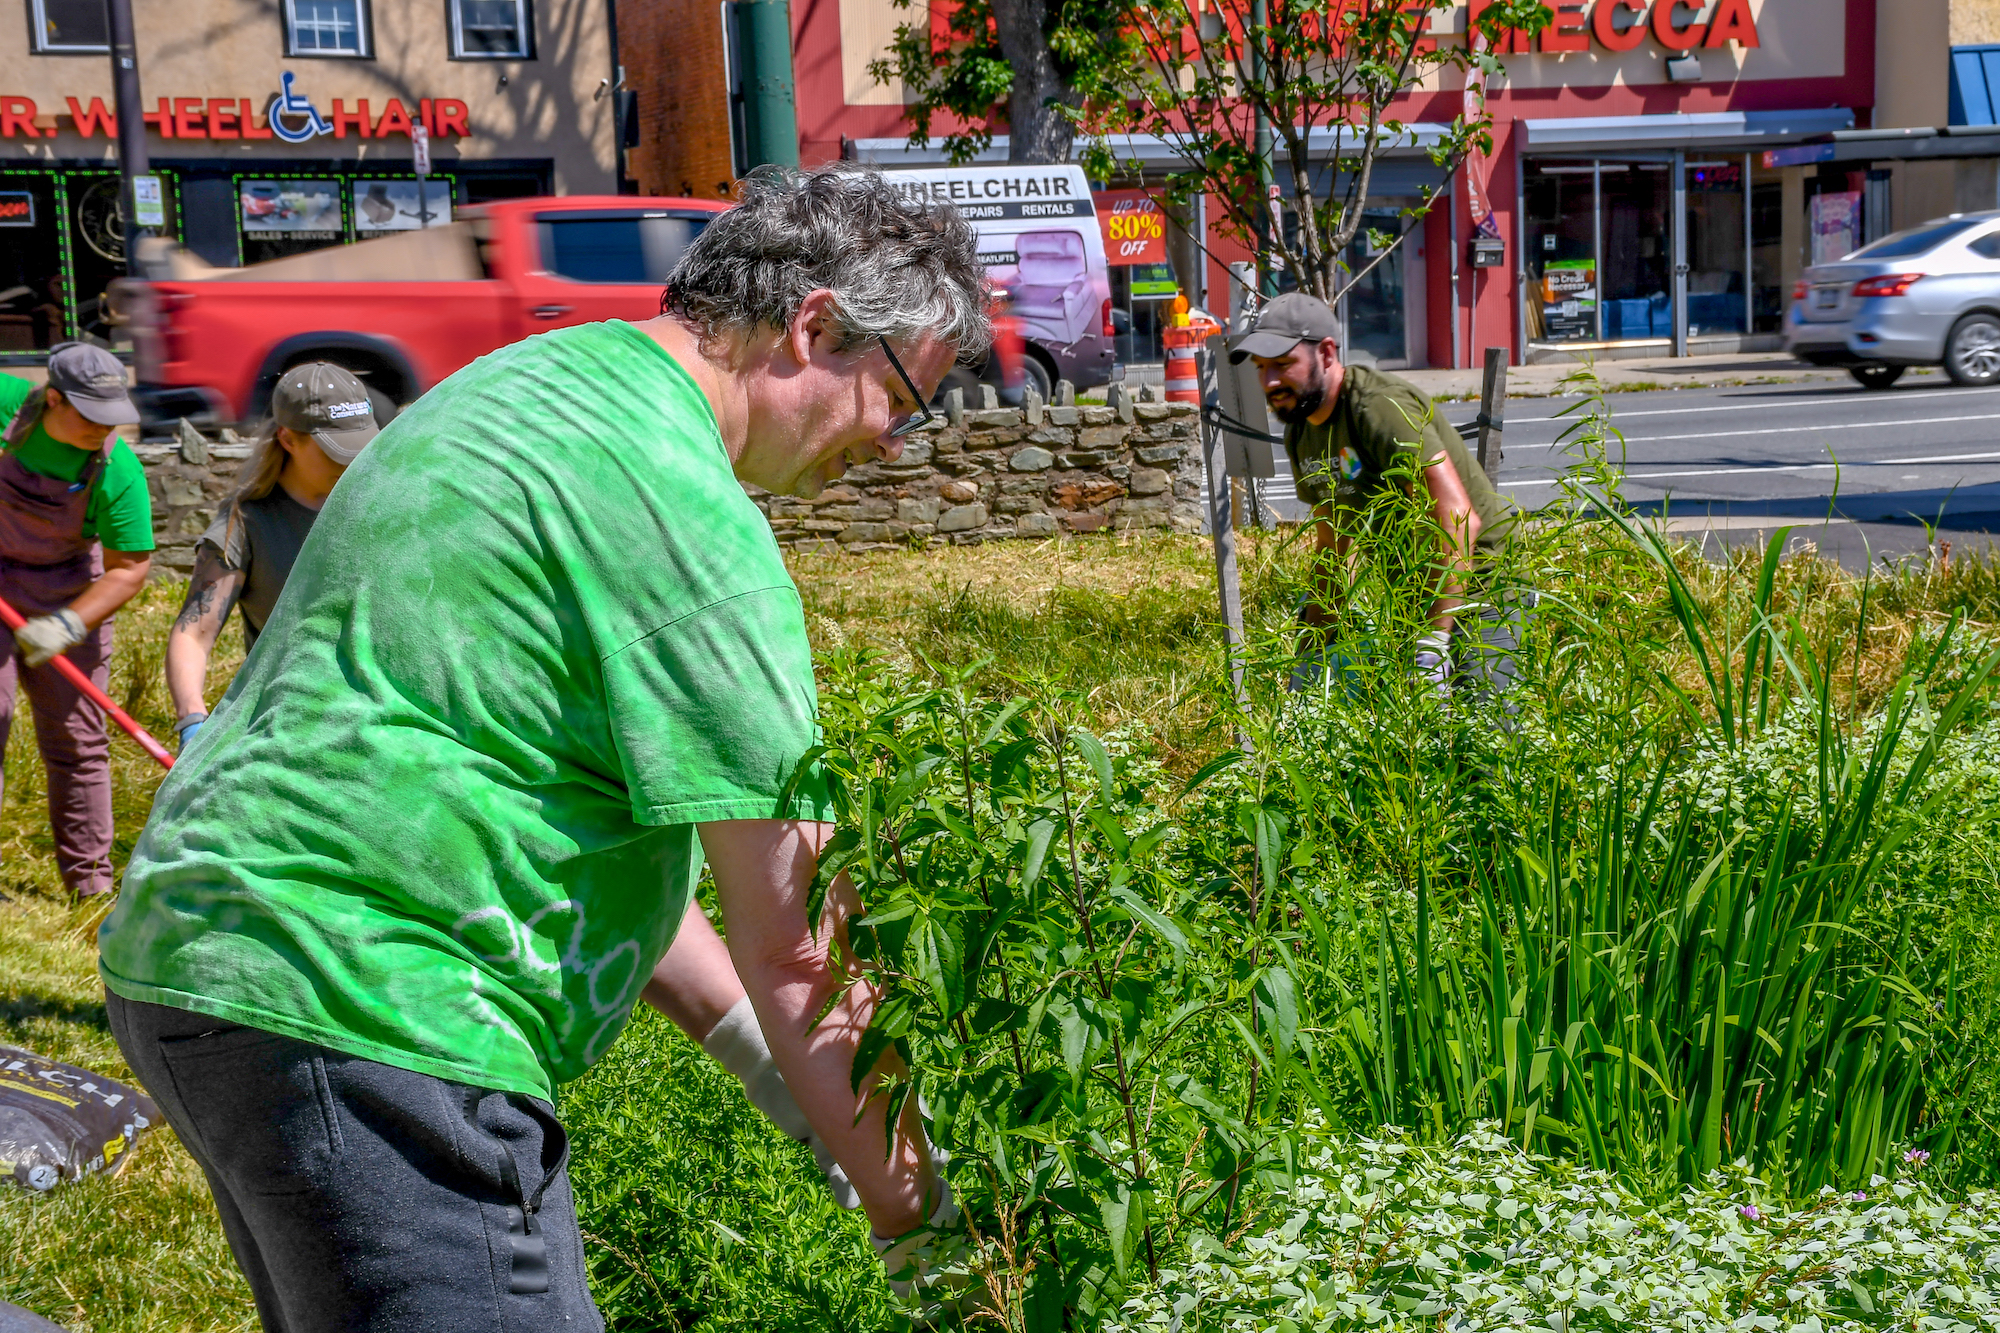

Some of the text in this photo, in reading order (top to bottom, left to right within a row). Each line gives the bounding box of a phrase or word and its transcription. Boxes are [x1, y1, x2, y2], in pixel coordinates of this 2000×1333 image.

[1022, 203, 1074, 216] RENTALS
[1112, 198, 1155, 214] UP TO
[1108, 213, 1162, 240] 80%
[248, 231, 336, 240] SALES SERVICE
[1120, 240, 1148, 256] OFF
[1548, 274, 1585, 284] No Credit
[1548, 282, 1590, 291] Necessary
[328, 401, 369, 412] The Nature
